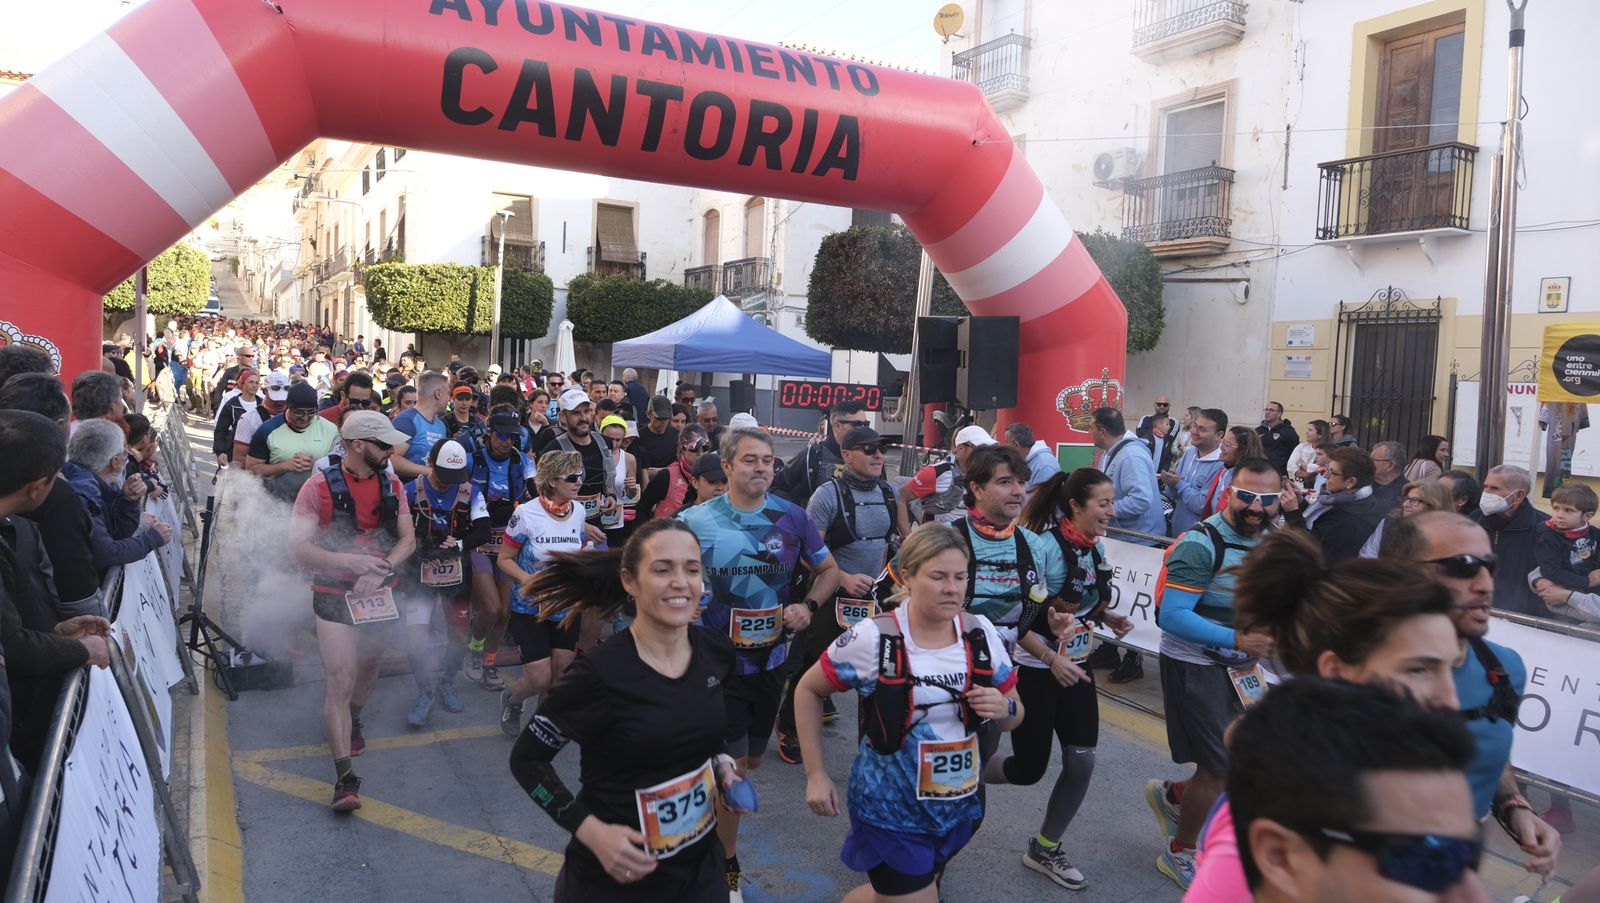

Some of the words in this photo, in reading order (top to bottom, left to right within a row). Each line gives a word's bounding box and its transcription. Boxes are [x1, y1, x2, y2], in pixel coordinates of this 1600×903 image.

[429, 0, 882, 97] AYUNTAMIENTO
[440, 46, 862, 182] CANTORIA
[1565, 362, 1593, 370] entre
[579, 500, 597, 509] 63
[356, 597, 386, 609] 113
[842, 605, 869, 618] 266
[740, 616, 776, 632] 225
[933, 750, 973, 775] 298
[657, 783, 707, 825] 375
